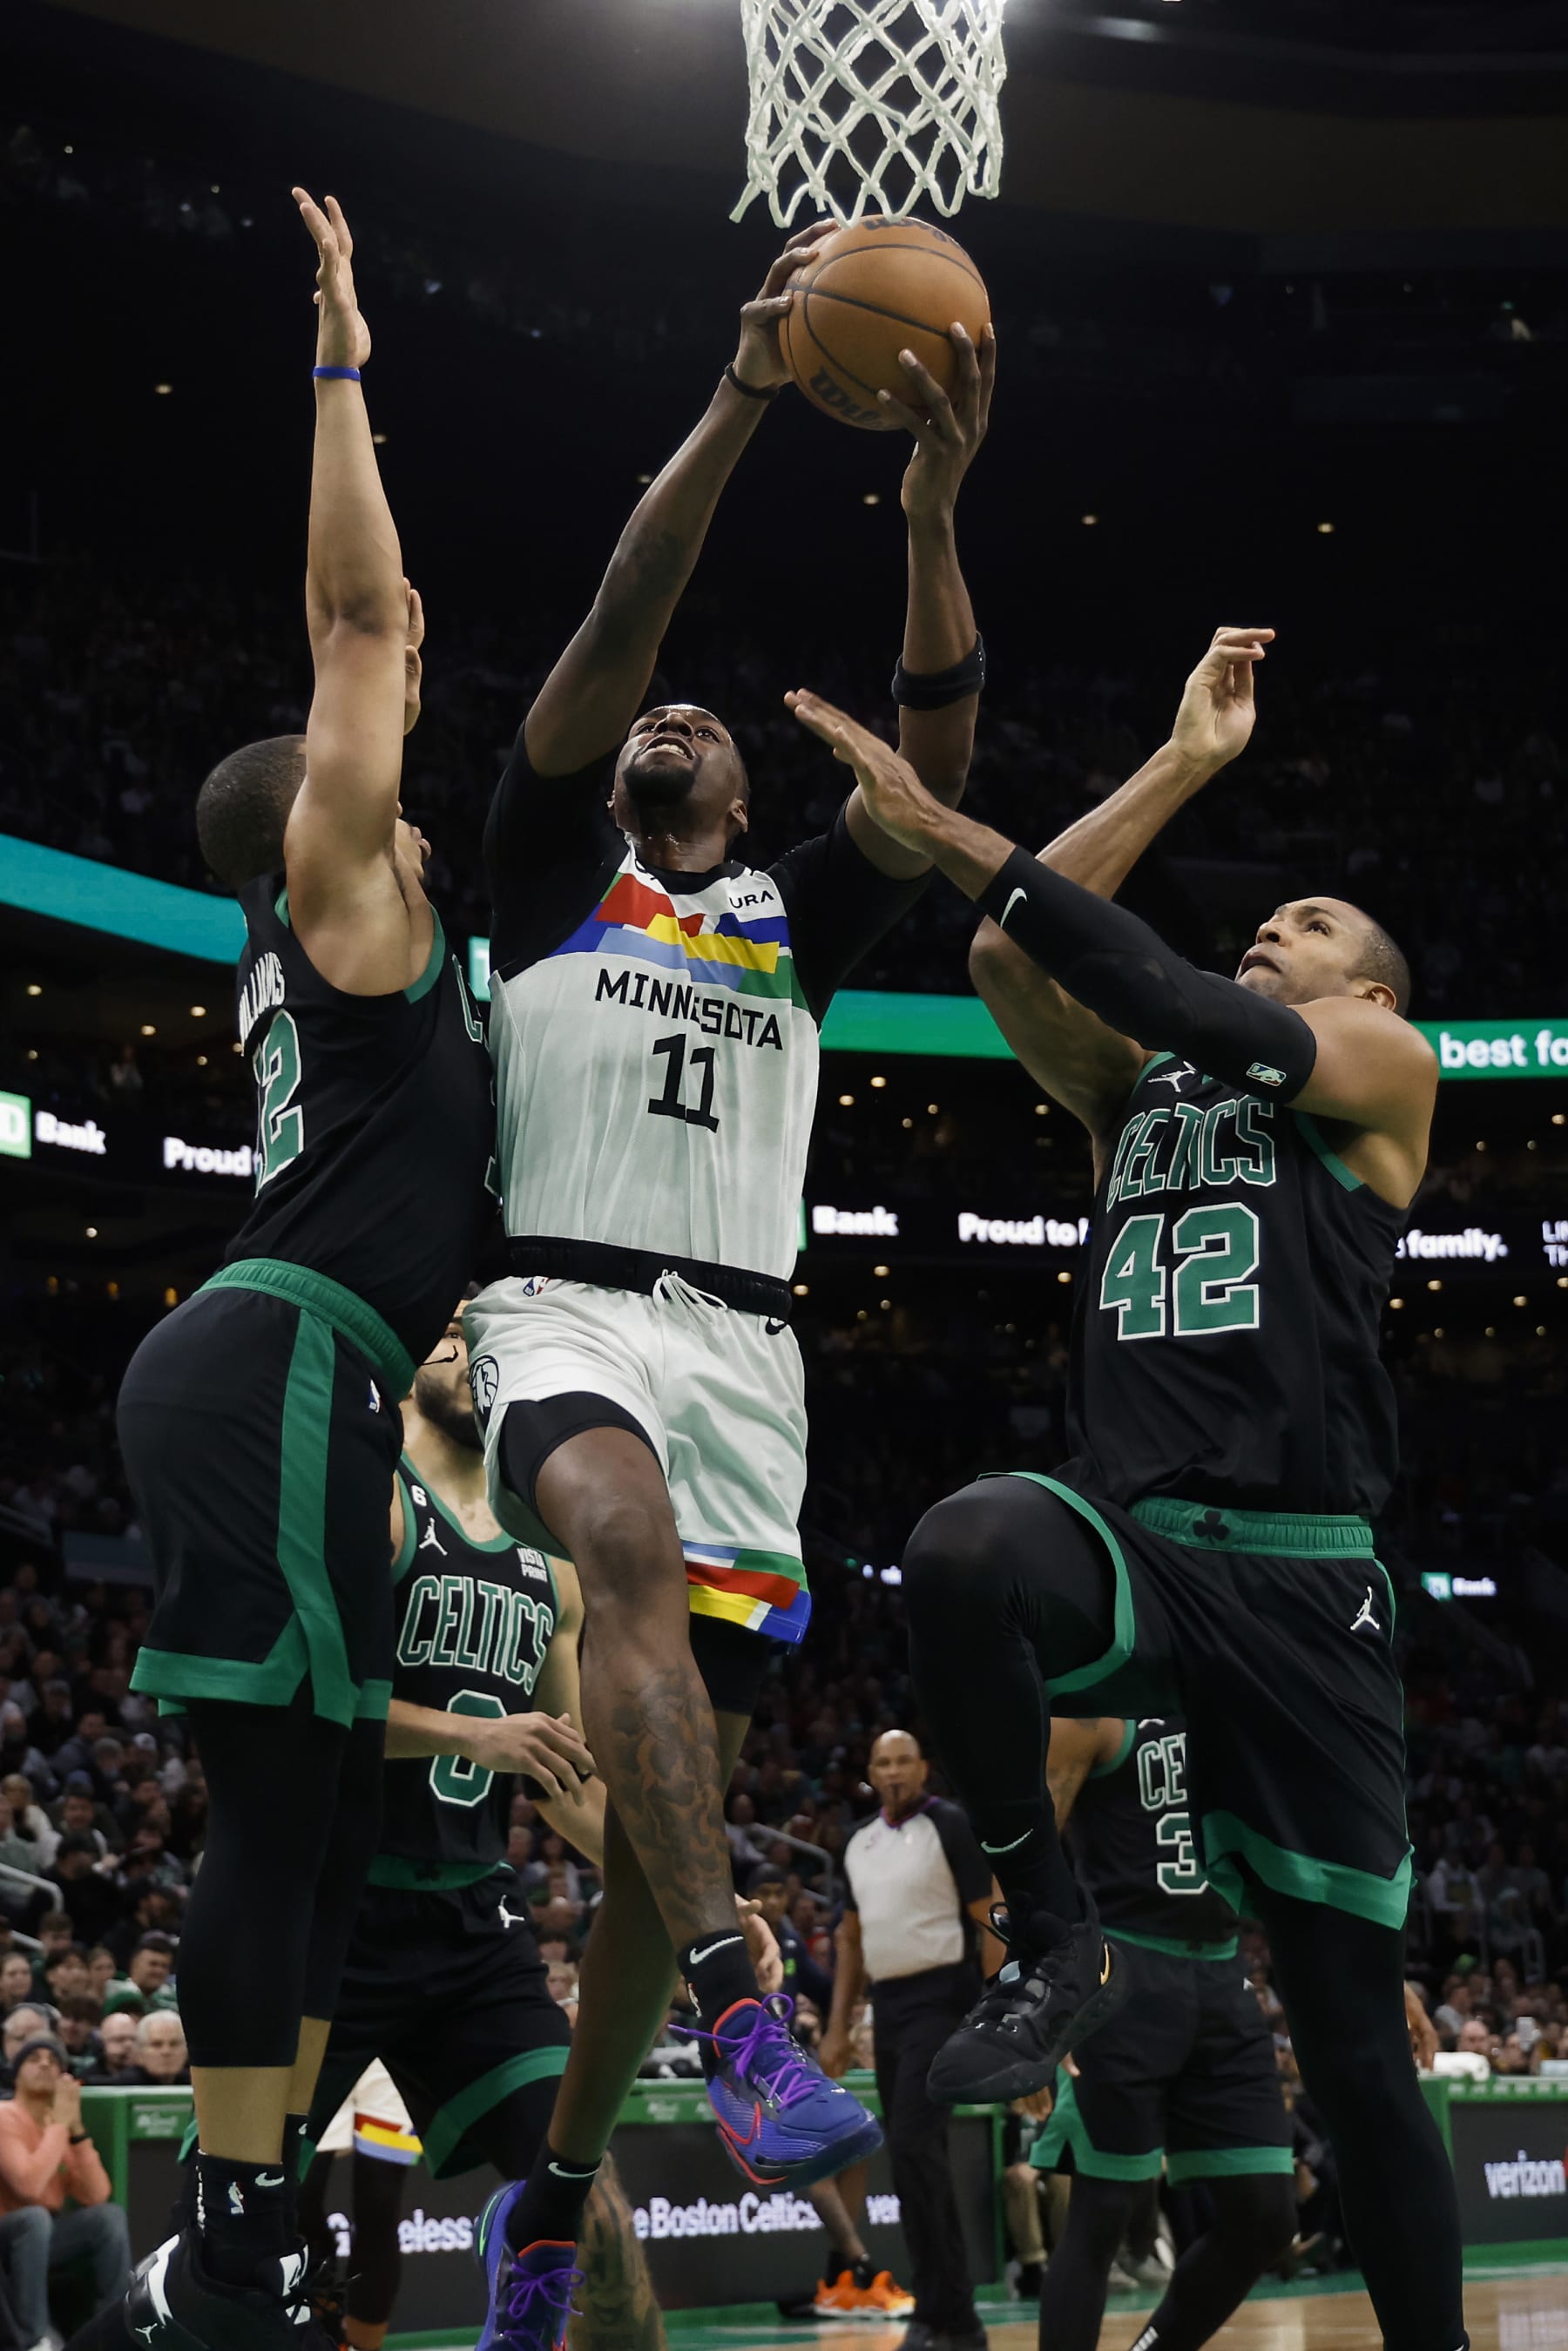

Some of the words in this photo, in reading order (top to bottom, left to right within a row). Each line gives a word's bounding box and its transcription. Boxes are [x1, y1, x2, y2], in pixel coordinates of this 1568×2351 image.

[729, 890, 774, 909] URA
[1439, 1032, 1528, 1068] best
[647, 1033, 720, 1133] 11
[36, 1111, 106, 1155] Bank
[164, 1136, 253, 1176] Proud
[812, 1205, 899, 1236] Bank
[958, 1212, 1045, 1245] Proud
[1045, 1219, 1078, 1246] to
[1406, 1229, 1508, 1262] family.
[1099, 1202, 1260, 1341] 42
[411, 1483, 427, 1507] 6
[397, 1575, 554, 1697] CELTICS
[649, 2196, 740, 2240] Boston
